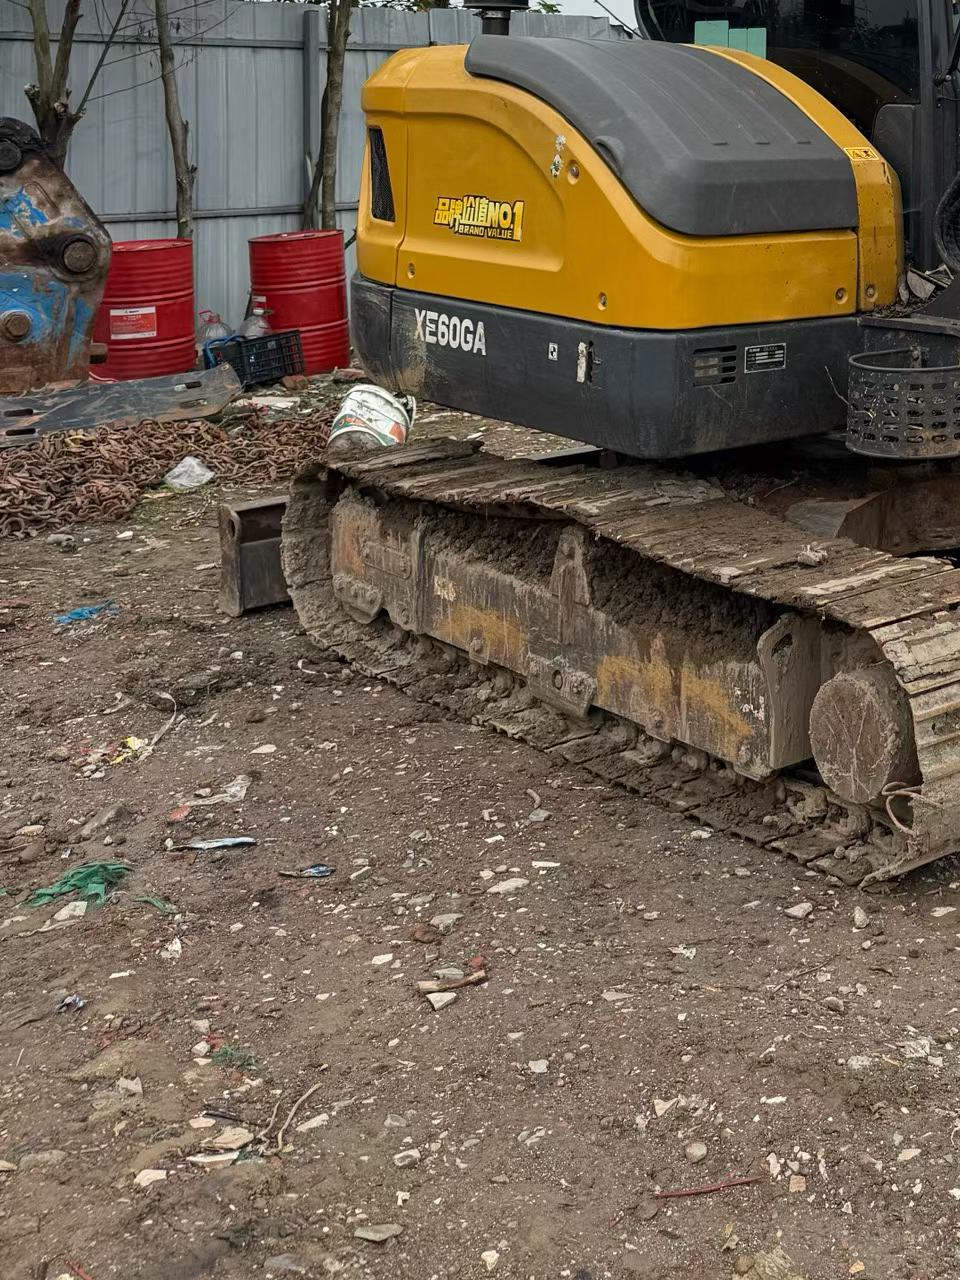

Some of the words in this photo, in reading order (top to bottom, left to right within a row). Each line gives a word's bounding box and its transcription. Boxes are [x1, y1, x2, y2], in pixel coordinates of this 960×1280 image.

[459, 225, 485, 236] BRAND
[487, 227, 512, 239] VALUE
[414, 308, 486, 356] XE60GA
